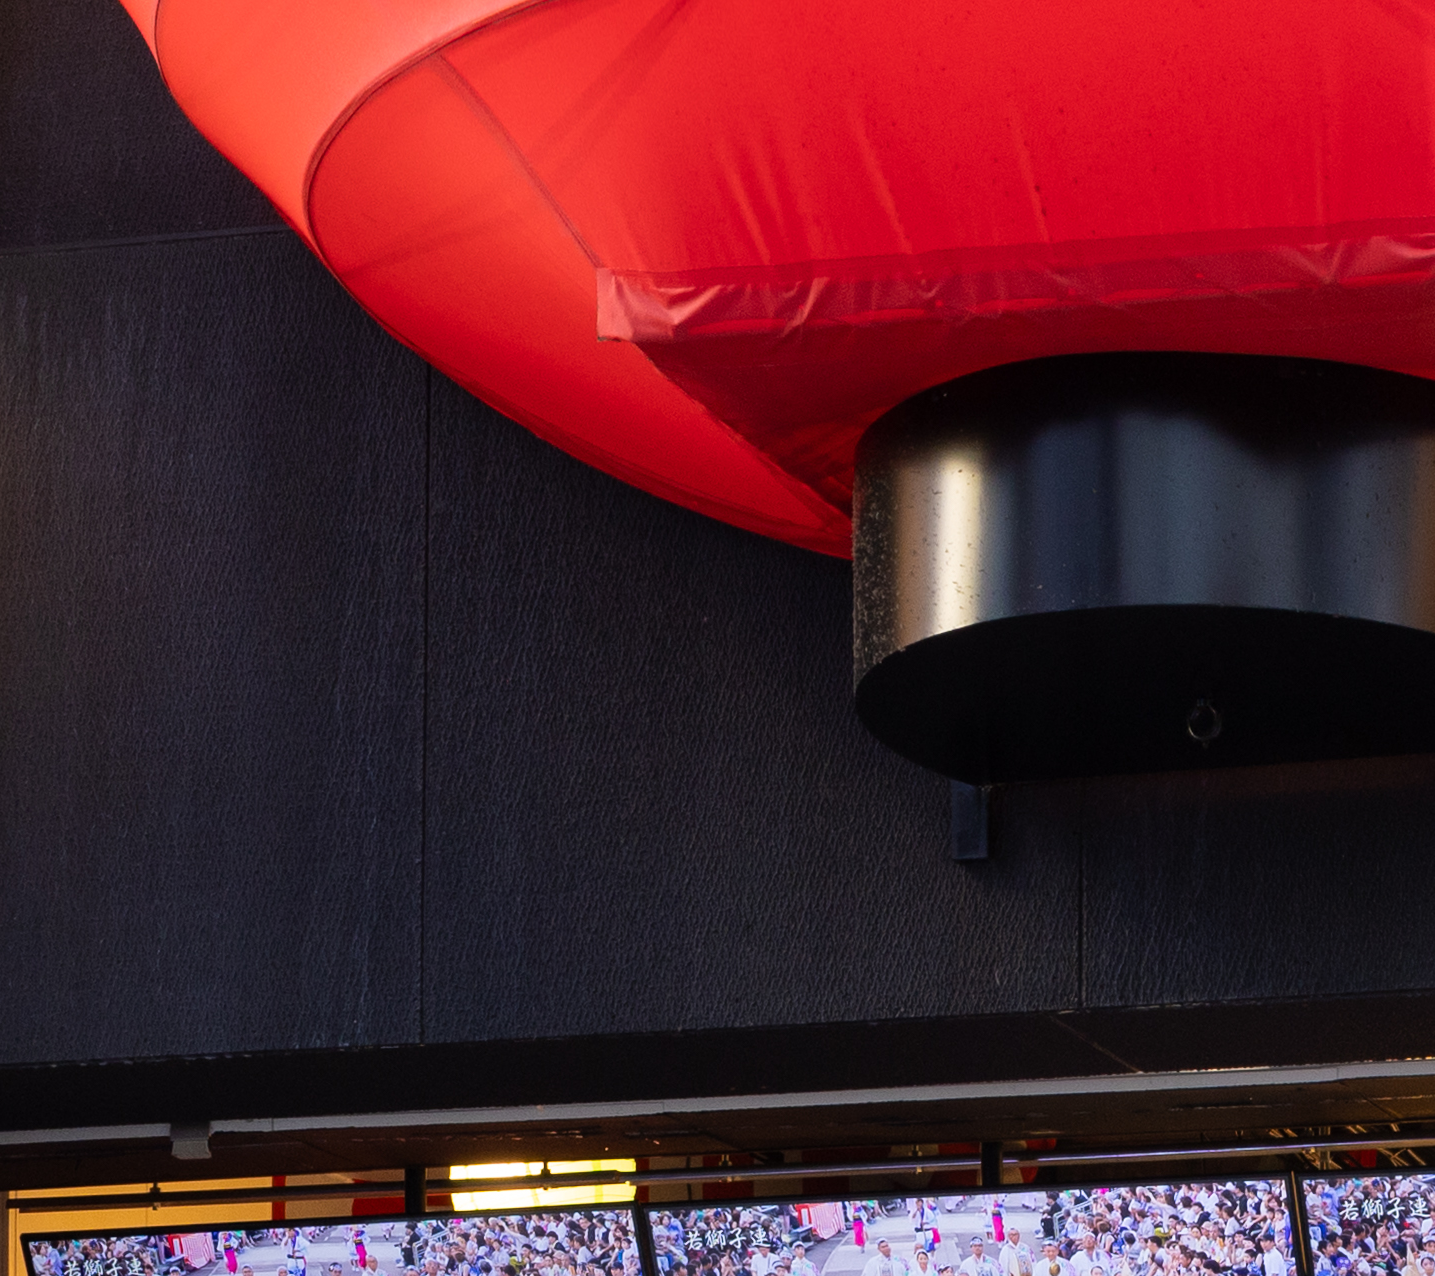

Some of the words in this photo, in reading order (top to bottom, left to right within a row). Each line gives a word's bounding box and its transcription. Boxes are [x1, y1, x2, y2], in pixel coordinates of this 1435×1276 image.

[1339, 1196, 1431, 1221] 若獅子連
[684, 1227, 772, 1251] 若獅子連
